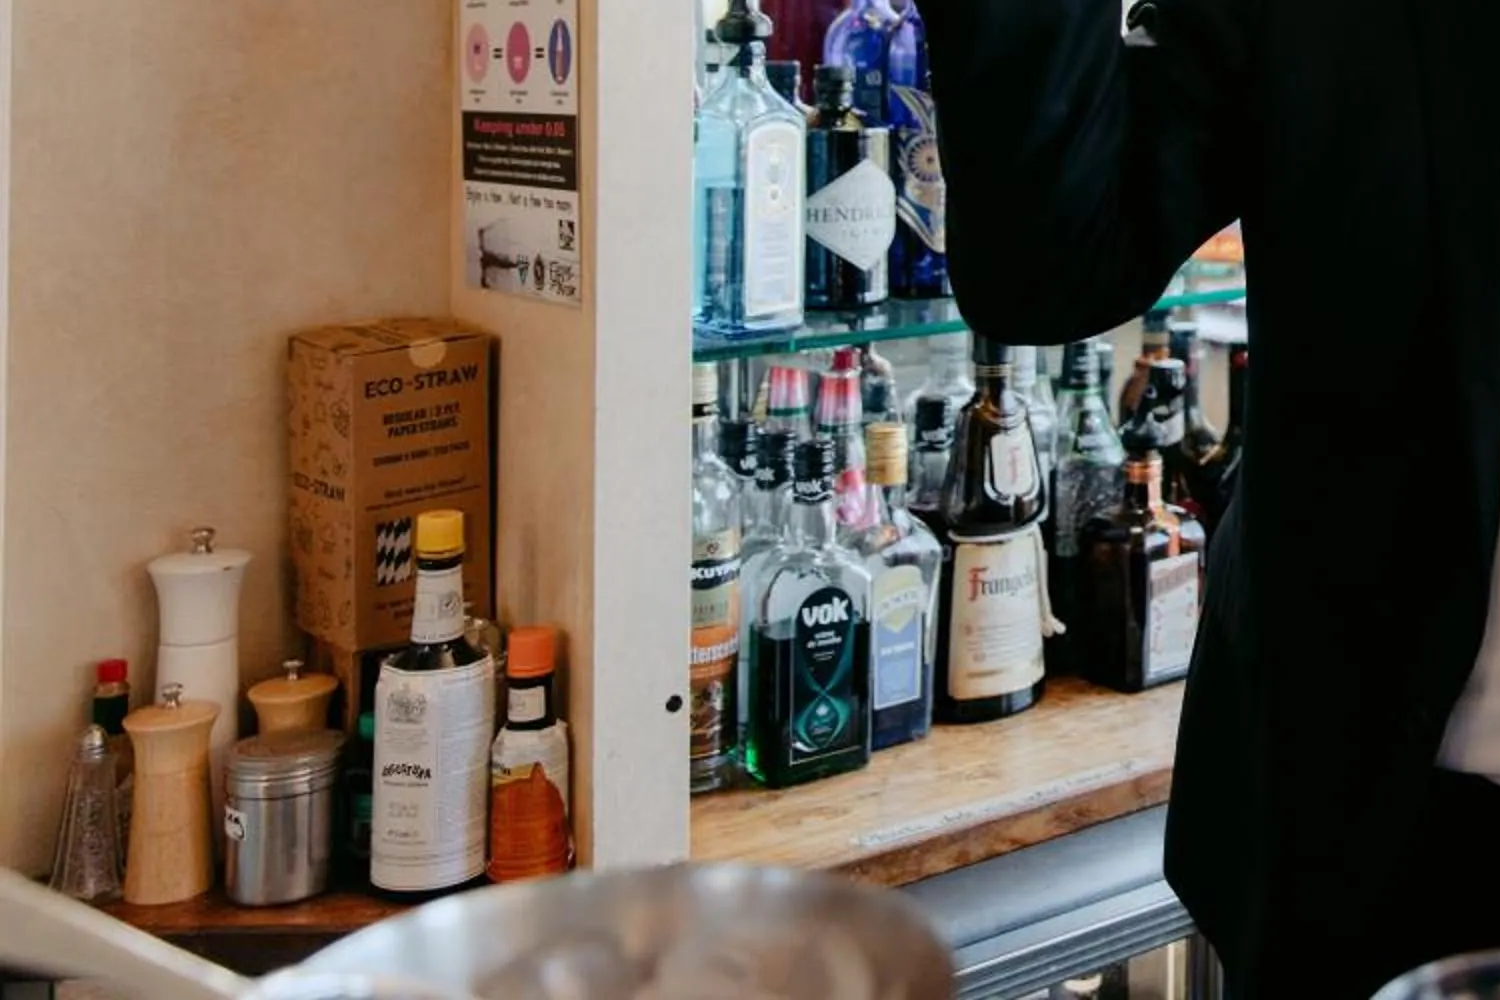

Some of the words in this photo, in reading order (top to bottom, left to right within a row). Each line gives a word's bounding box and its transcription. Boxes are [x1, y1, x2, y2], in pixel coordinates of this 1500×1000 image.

[364, 363, 479, 400] ECO-STRAW
[740, 453, 758, 471] vo
[801, 596, 849, 628] vok
